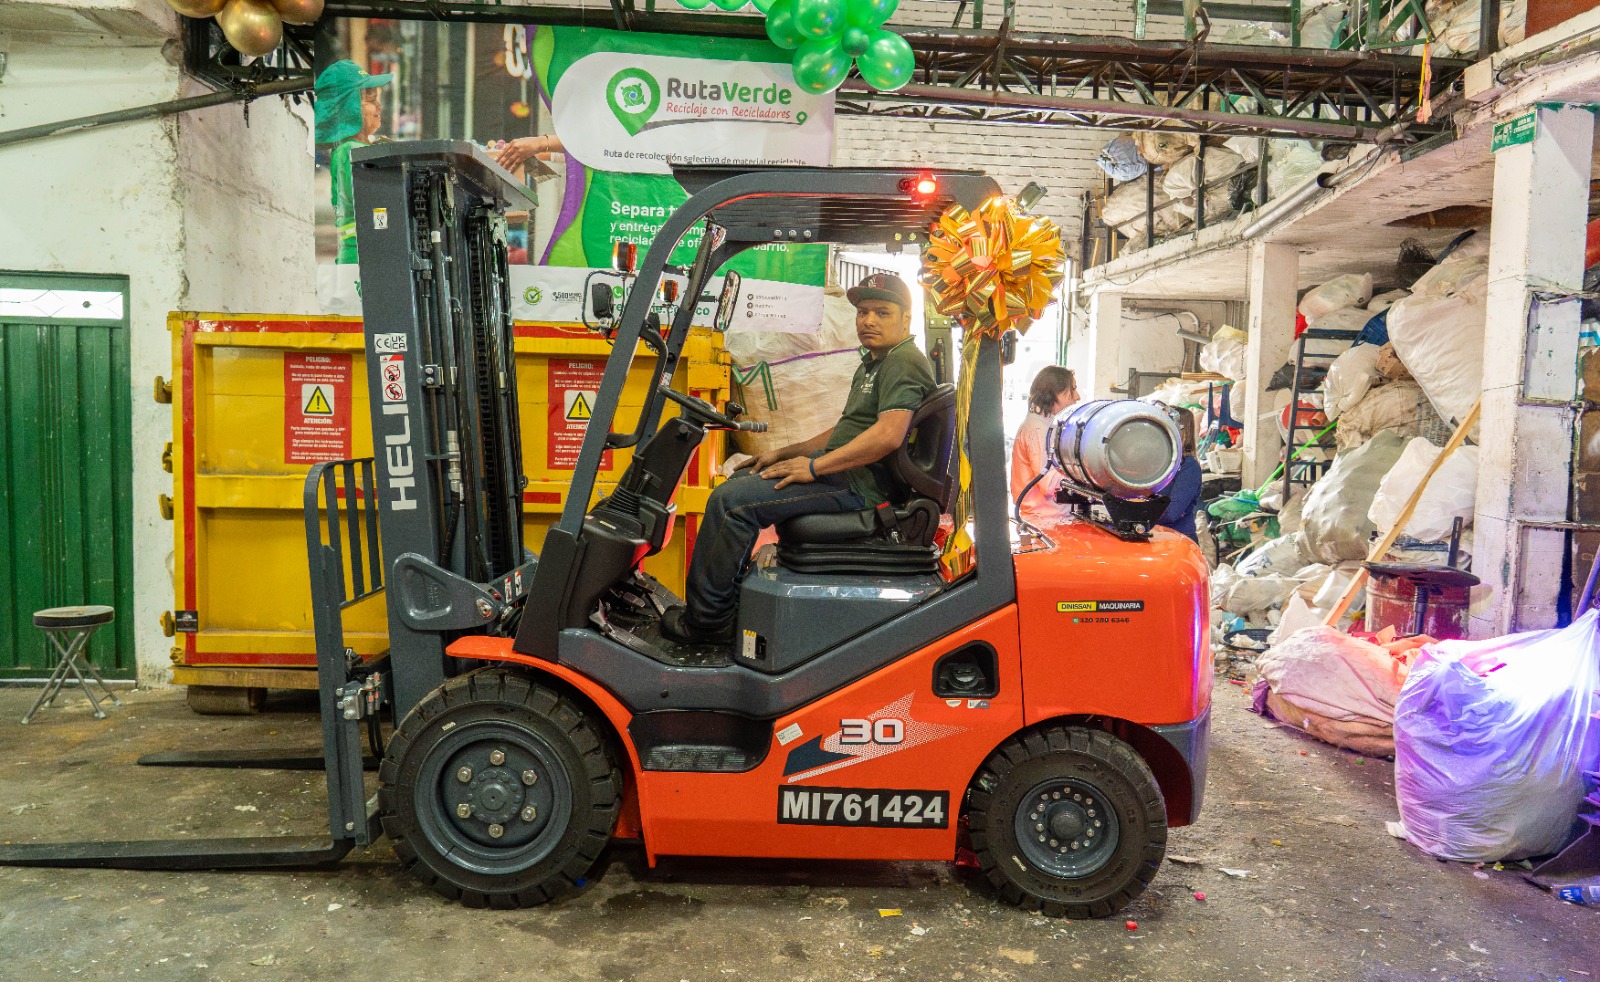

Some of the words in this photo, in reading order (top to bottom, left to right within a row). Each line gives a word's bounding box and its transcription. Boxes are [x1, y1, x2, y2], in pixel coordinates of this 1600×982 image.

[667, 77, 792, 105] RutaVerde
[666, 102, 708, 117] Reciclaje
[711, 107, 728, 115] con
[731, 106, 791, 119] Recicladores
[603, 149, 622, 158] Ruta
[624, 150, 635, 159] de
[635, 152, 682, 161] recolección
[683, 154, 720, 164] selectiva
[610, 201, 665, 218] Separa
[669, 205, 679, 217] t
[610, 222, 617, 233] y
[609, 234, 655, 245] reciclad
[376, 338, 391, 348] CE
[392, 342, 406, 350] CA
[382, 403, 417, 511] HELI
[1098, 602, 1141, 610] MAQUINARIA
[839, 718, 904, 745] 30
[782, 790, 944, 824] MI761424
